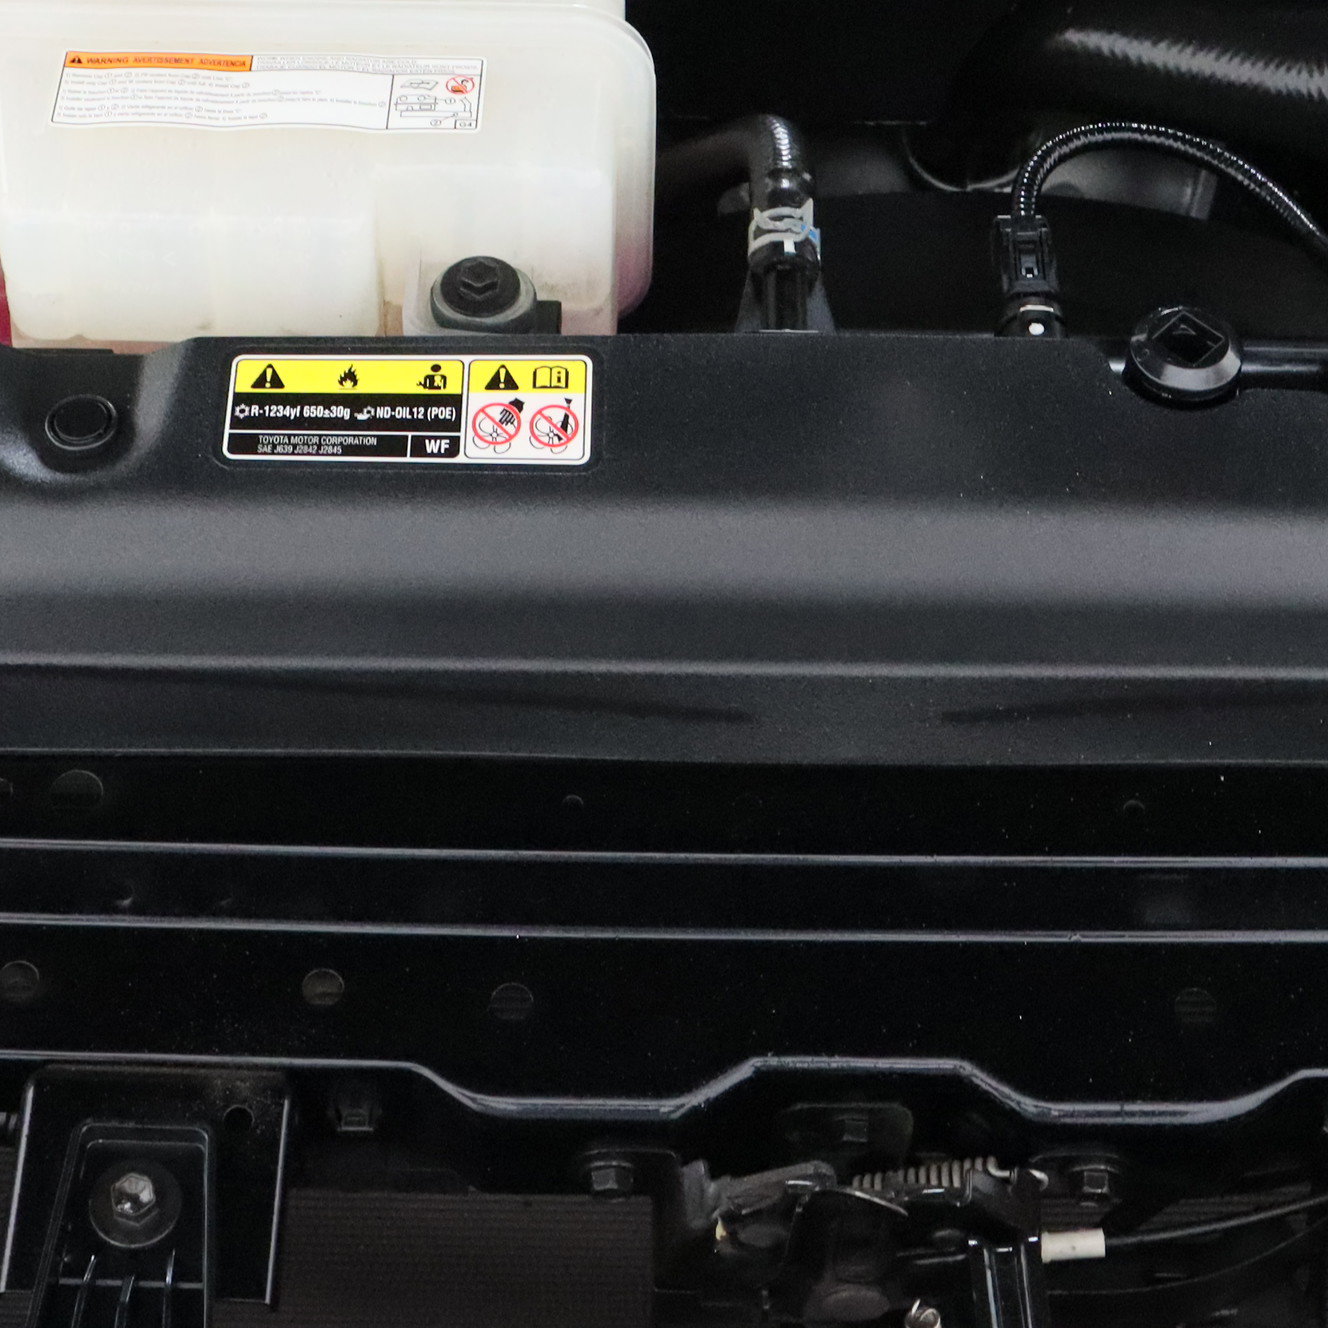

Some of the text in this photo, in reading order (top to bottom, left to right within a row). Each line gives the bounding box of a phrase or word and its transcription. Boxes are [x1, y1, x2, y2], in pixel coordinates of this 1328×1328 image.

[86, 57, 129, 65] WARNING
[250, 404, 301, 420] R-1234yf
[303, 405, 351, 421] 650±30g
[427, 406, 456, 422] (POE)
[258, 435, 378, 446] TOYOTA MOTOR CORPORATION
[424, 438, 450, 454] WF
[257, 444, 343, 455] SAE J639 J2842 J2845
